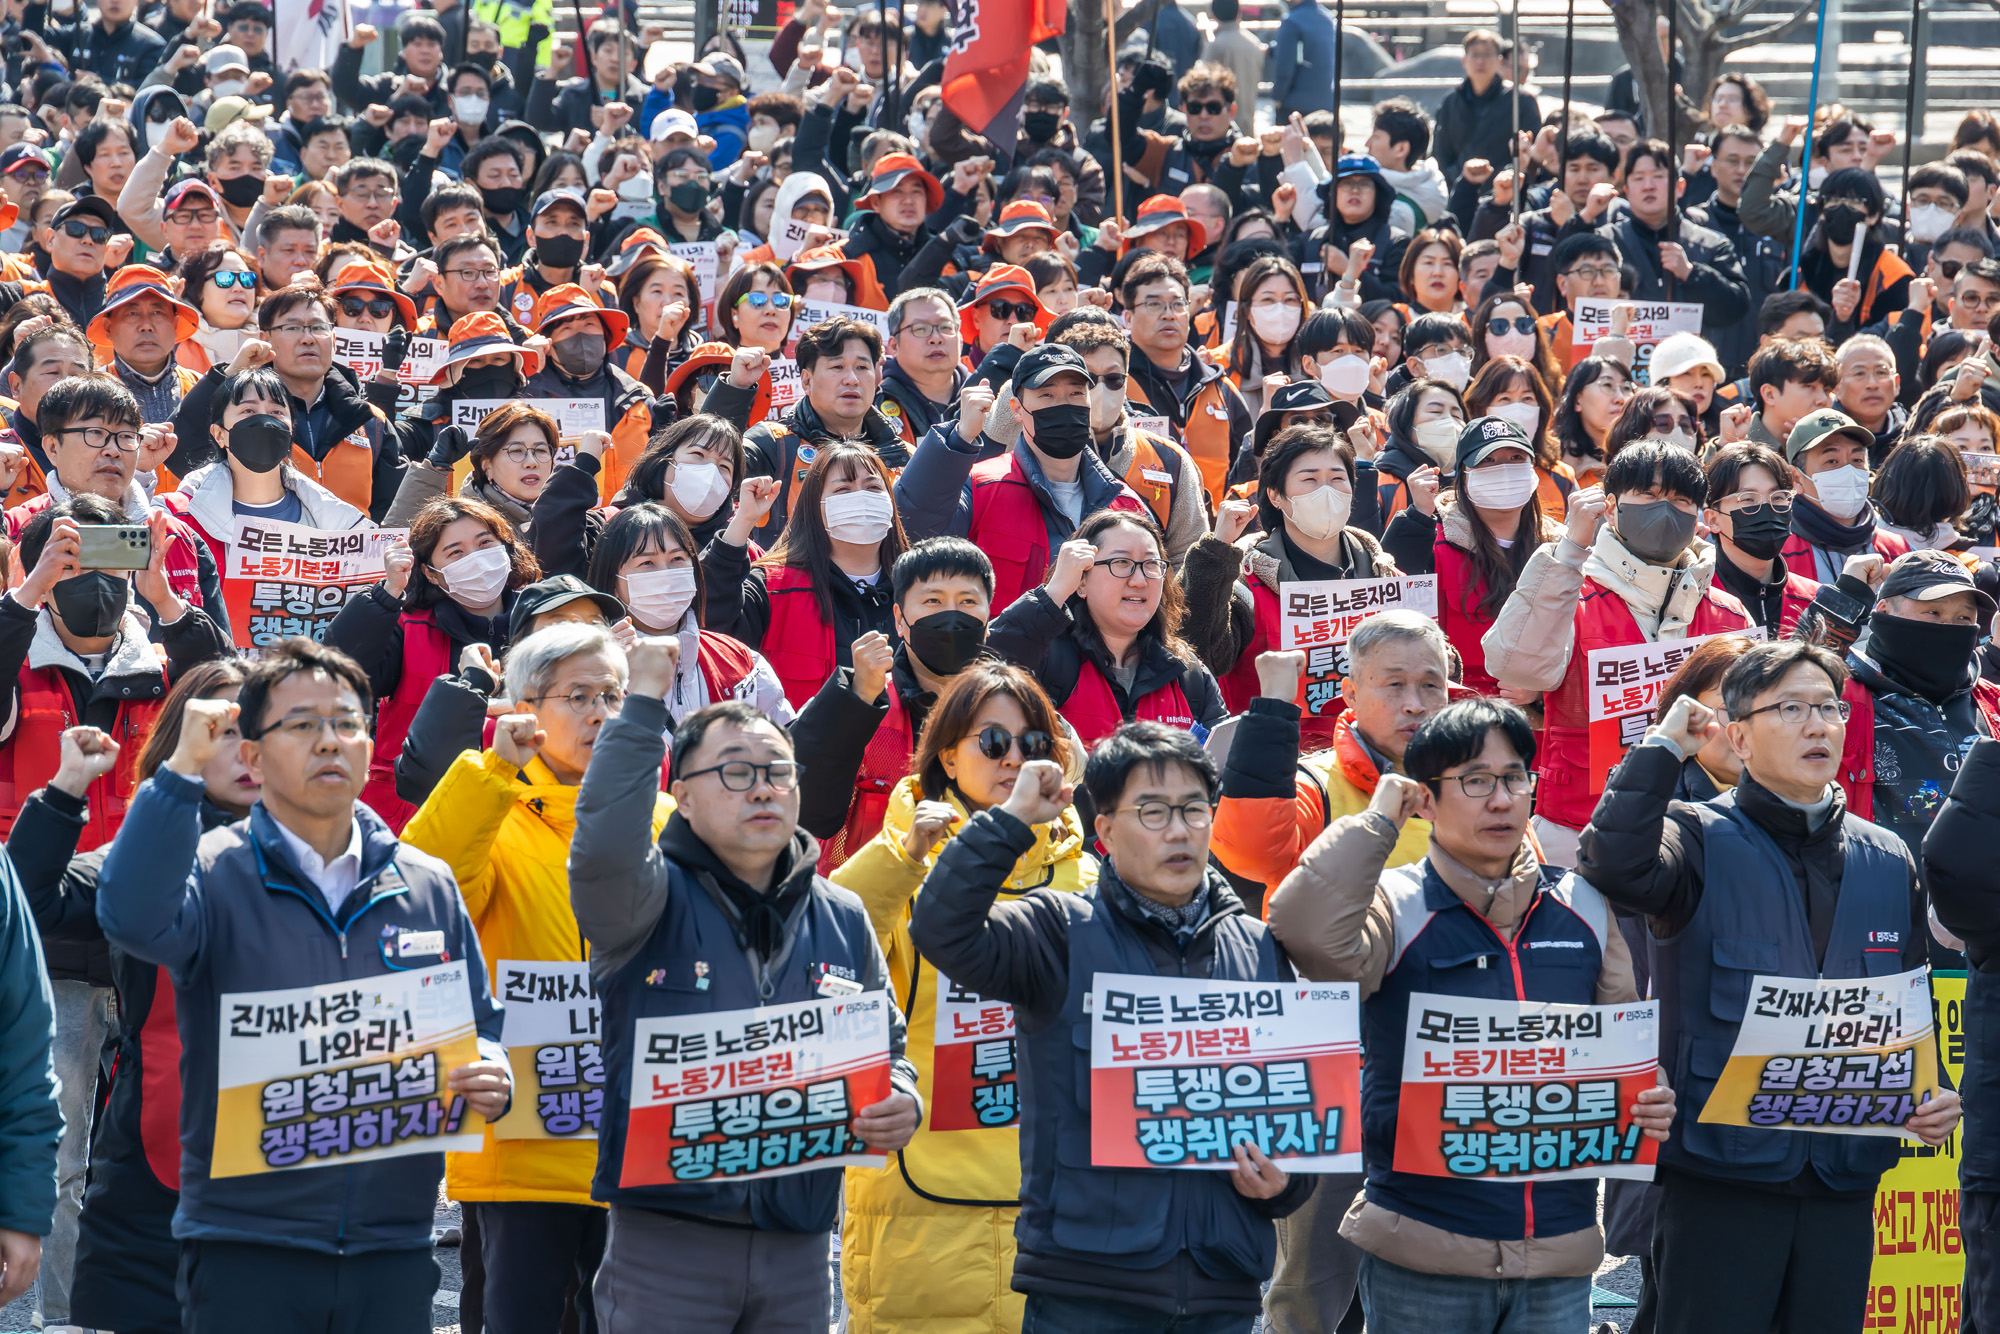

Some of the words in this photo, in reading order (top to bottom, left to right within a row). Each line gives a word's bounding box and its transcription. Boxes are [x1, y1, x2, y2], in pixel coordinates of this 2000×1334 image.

[1580, 306, 1610, 323] 모든
[238, 526, 282, 552] 모든
[287, 533, 364, 557] 노동자의
[240, 556, 340, 580] 노동기본권
[1287, 593, 1329, 617] 모든
[1332, 581, 1402, 613] 노동자의
[1596, 660, 1640, 686] 모든
[231, 989, 362, 1037] 진짜사장
[1102, 989, 1164, 1025] 모든
[1170, 989, 1284, 1023] 노동자의
[1311, 990, 1350, 1001] 민주노총
[1754, 986, 1870, 1018] 진짜사장
[299, 1009, 415, 1066] 나와라!
[644, 1032, 707, 1064] 모든
[715, 1006, 825, 1056] 노동자의
[1111, 1026, 1252, 1062] 노동기본권
[1416, 1009, 1480, 1043] 모든
[1488, 1012, 1602, 1043] 노동자의
[1804, 1007, 1901, 1049] 나와라!
[652, 1051, 794, 1100] 노동기본권
[1423, 1047, 1566, 1077] 노동기본권
[1760, 1048, 1914, 1091] 원청교섭
[261, 1051, 438, 1124] 원청교섭
[1134, 1060, 1314, 1114] 투쟁으로
[1441, 1080, 1619, 1128] 투쟁으로
[260, 1094, 468, 1167] 쟁취하자!
[670, 1077, 849, 1142] 투쟁으로
[1137, 1106, 1343, 1165] 쟁취하자!
[1440, 1124, 1643, 1176] 쟁취하자!
[1874, 1190, 1916, 1256] 선고
